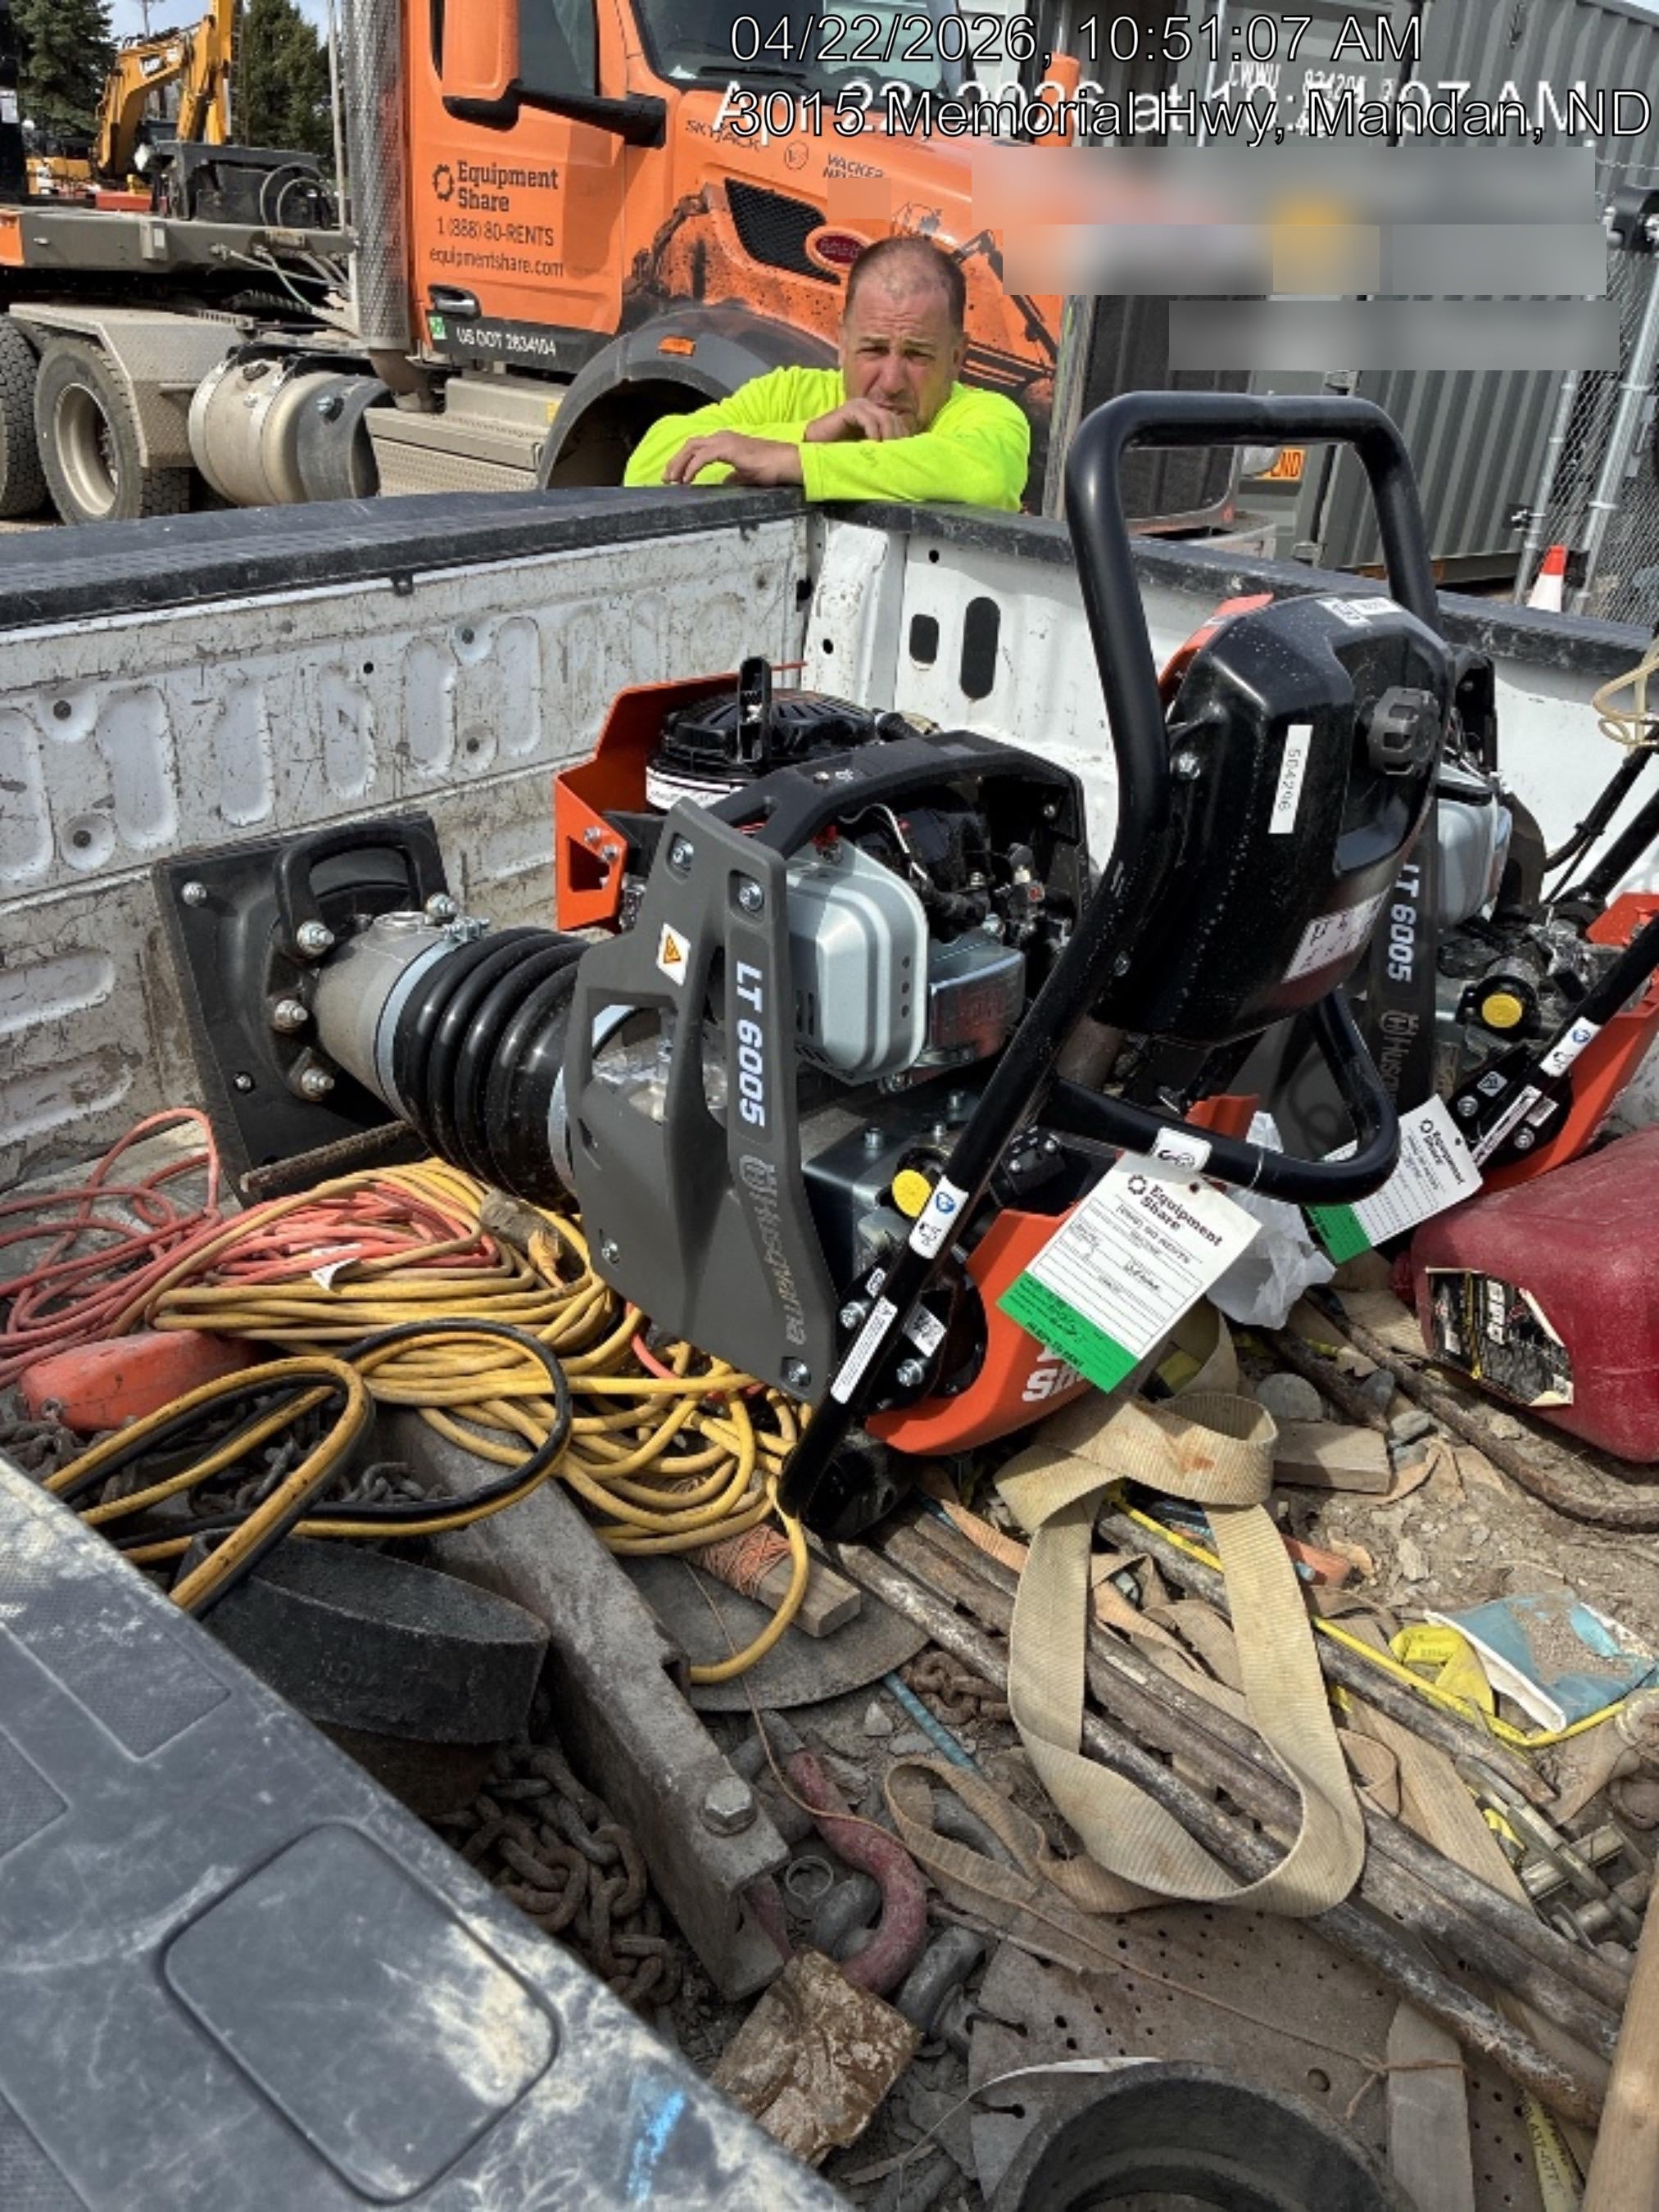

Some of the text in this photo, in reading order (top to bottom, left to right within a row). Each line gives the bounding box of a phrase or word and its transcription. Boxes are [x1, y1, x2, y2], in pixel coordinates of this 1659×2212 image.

[456, 160, 559, 190] Equipment
[458, 186, 510, 212] Share
[483, 220, 555, 247] 80-RENTS
[429, 246, 564, 277] equipmentshare.com
[476, 329, 502, 350] DOT
[1387, 903, 1417, 983] 6005
[737, 960, 766, 1128] LT 6005
[1140, 1195, 1181, 1232] Share
[1149, 1184, 1224, 1247] Equipment
